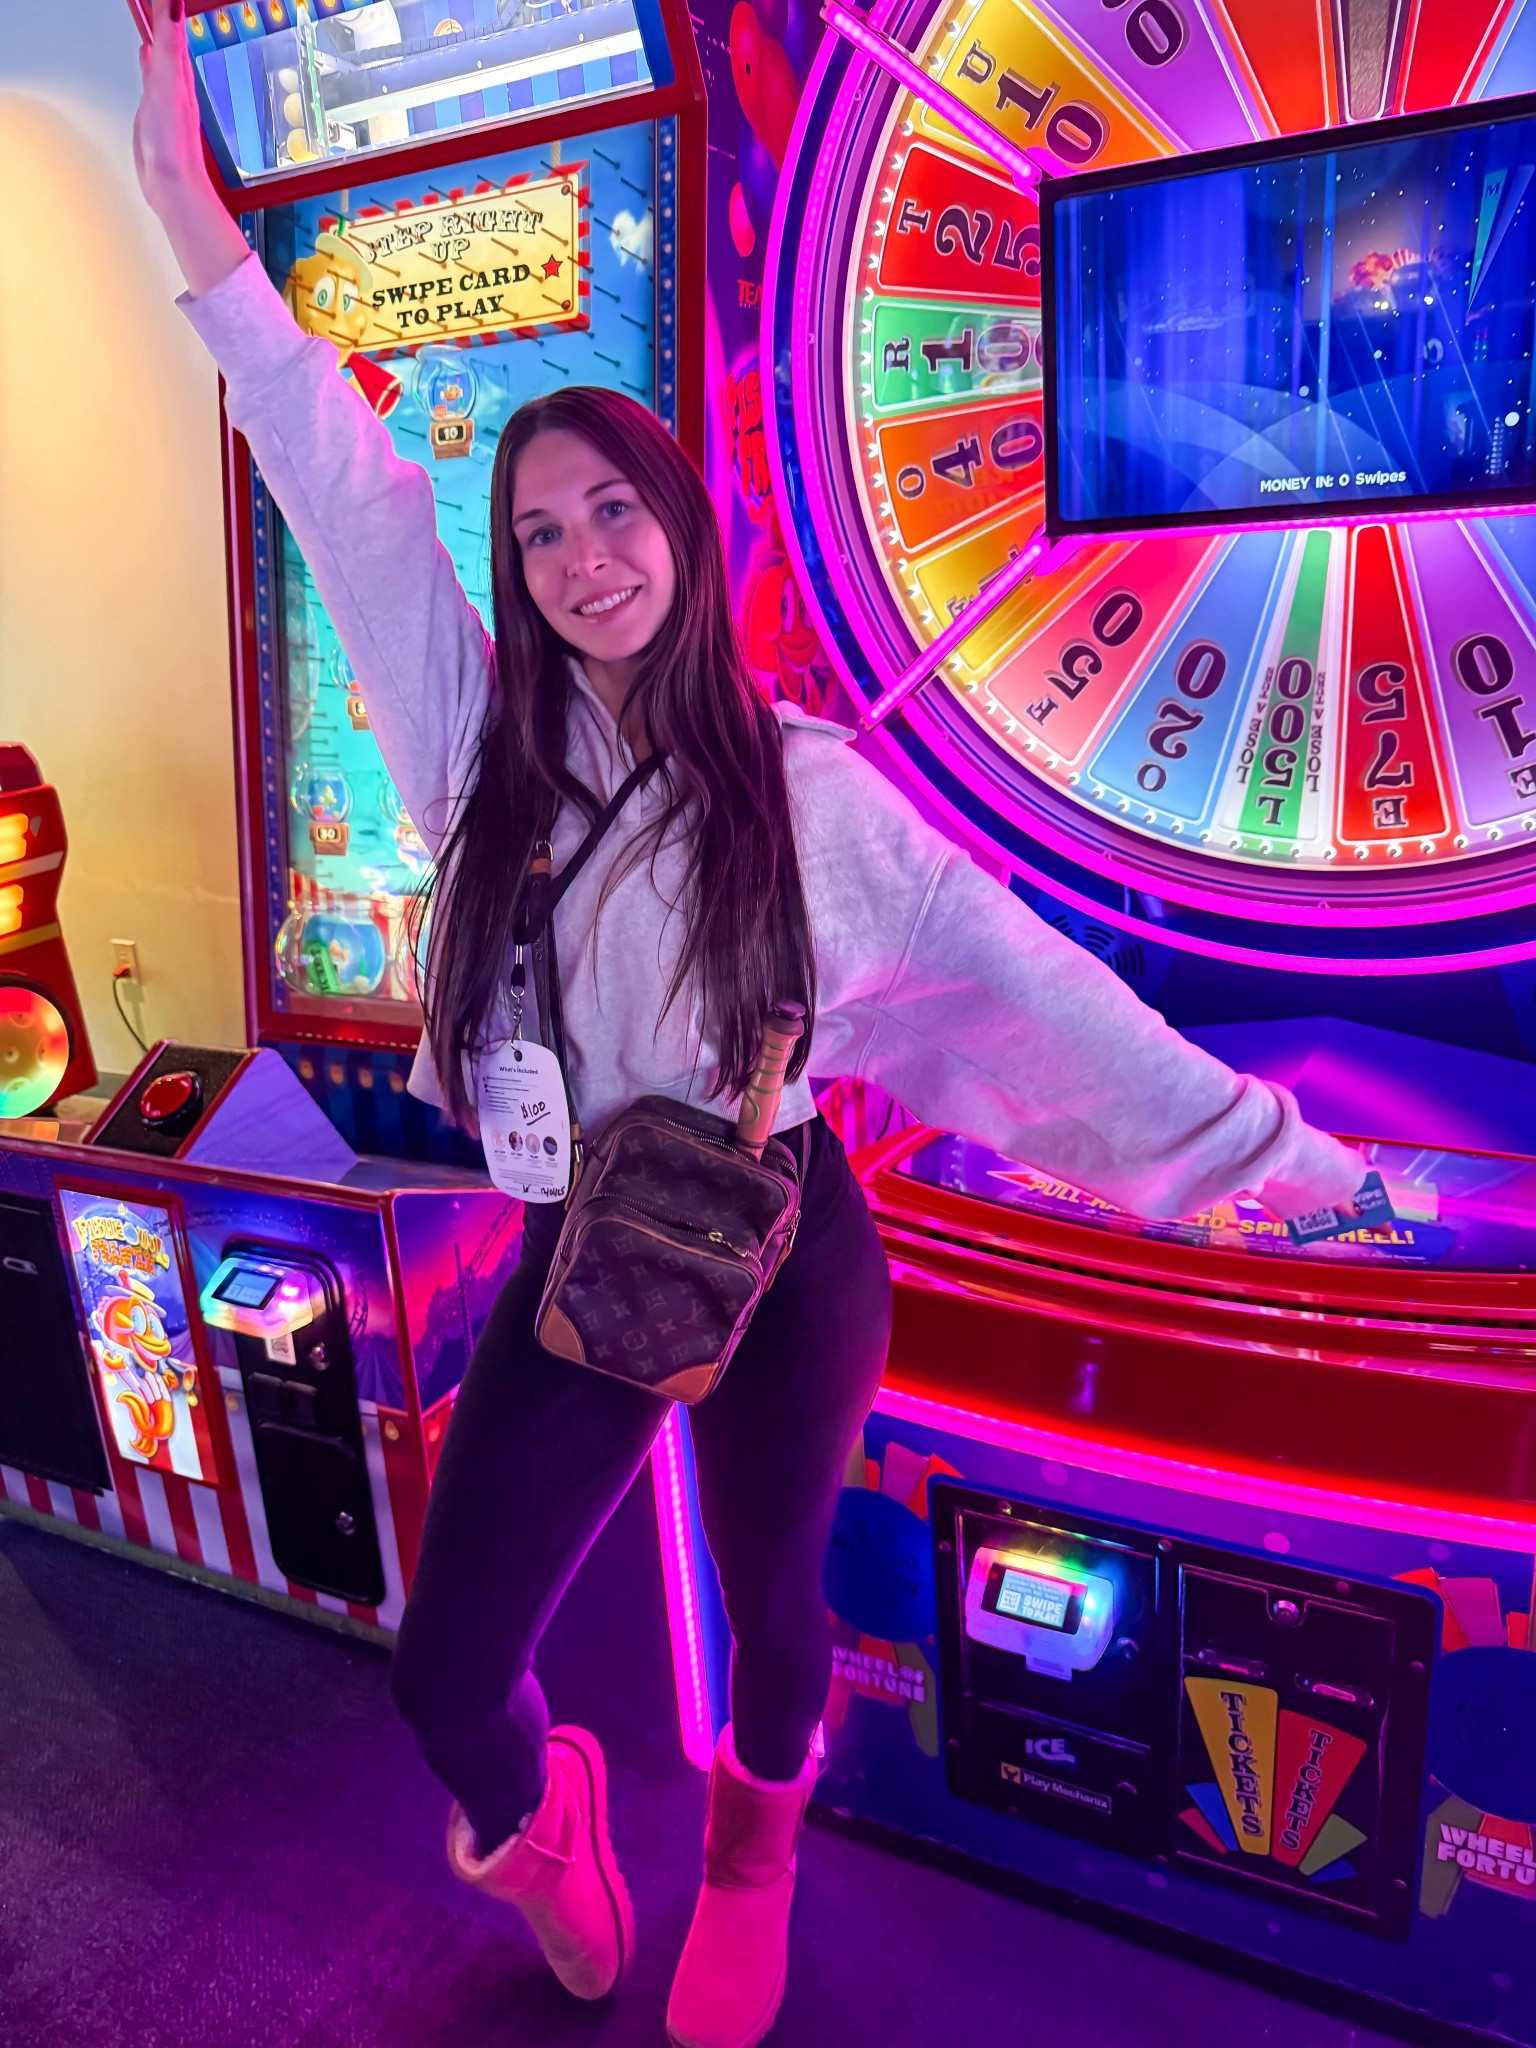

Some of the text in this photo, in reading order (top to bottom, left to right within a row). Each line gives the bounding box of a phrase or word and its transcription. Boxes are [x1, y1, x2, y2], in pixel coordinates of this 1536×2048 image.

[957, 40, 995, 84] U
[439, 209, 543, 237] RIGHT
[897, 199, 930, 235] T
[430, 238, 470, 263] UP
[372, 263, 531, 308] SWIPE CARD
[397, 294, 504, 329] TO PLAY
[883, 336, 911, 373] R
[443, 426, 459, 441] 10
[931, 419, 1044, 491] 40
[1259, 476, 1311, 493] MONEY
[1315, 475, 1334, 489] IN:
[1355, 470, 1407, 486] Swipes
[1044, 588, 1145, 701] 50
[1148, 641, 1229, 760] 20
[1256, 656, 1313, 826] L 500
[1357, 662, 1414, 828] E 75
[1028, 1180, 1080, 1203] PULL
[1197, 1213, 1227, 1230] TO
[1022, 1605, 1060, 1623] TO PLAY!
[1023, 1595, 1063, 1615] SWIPE
[1025, 1738, 1076, 1763] ICE
[1220, 1691, 1264, 1836] TICKETS
[1023, 1771, 1108, 1809] Play Mechanix
[1280, 1729, 1332, 1849] TICKETS
[1440, 1823, 1536, 1869] WHEEL
